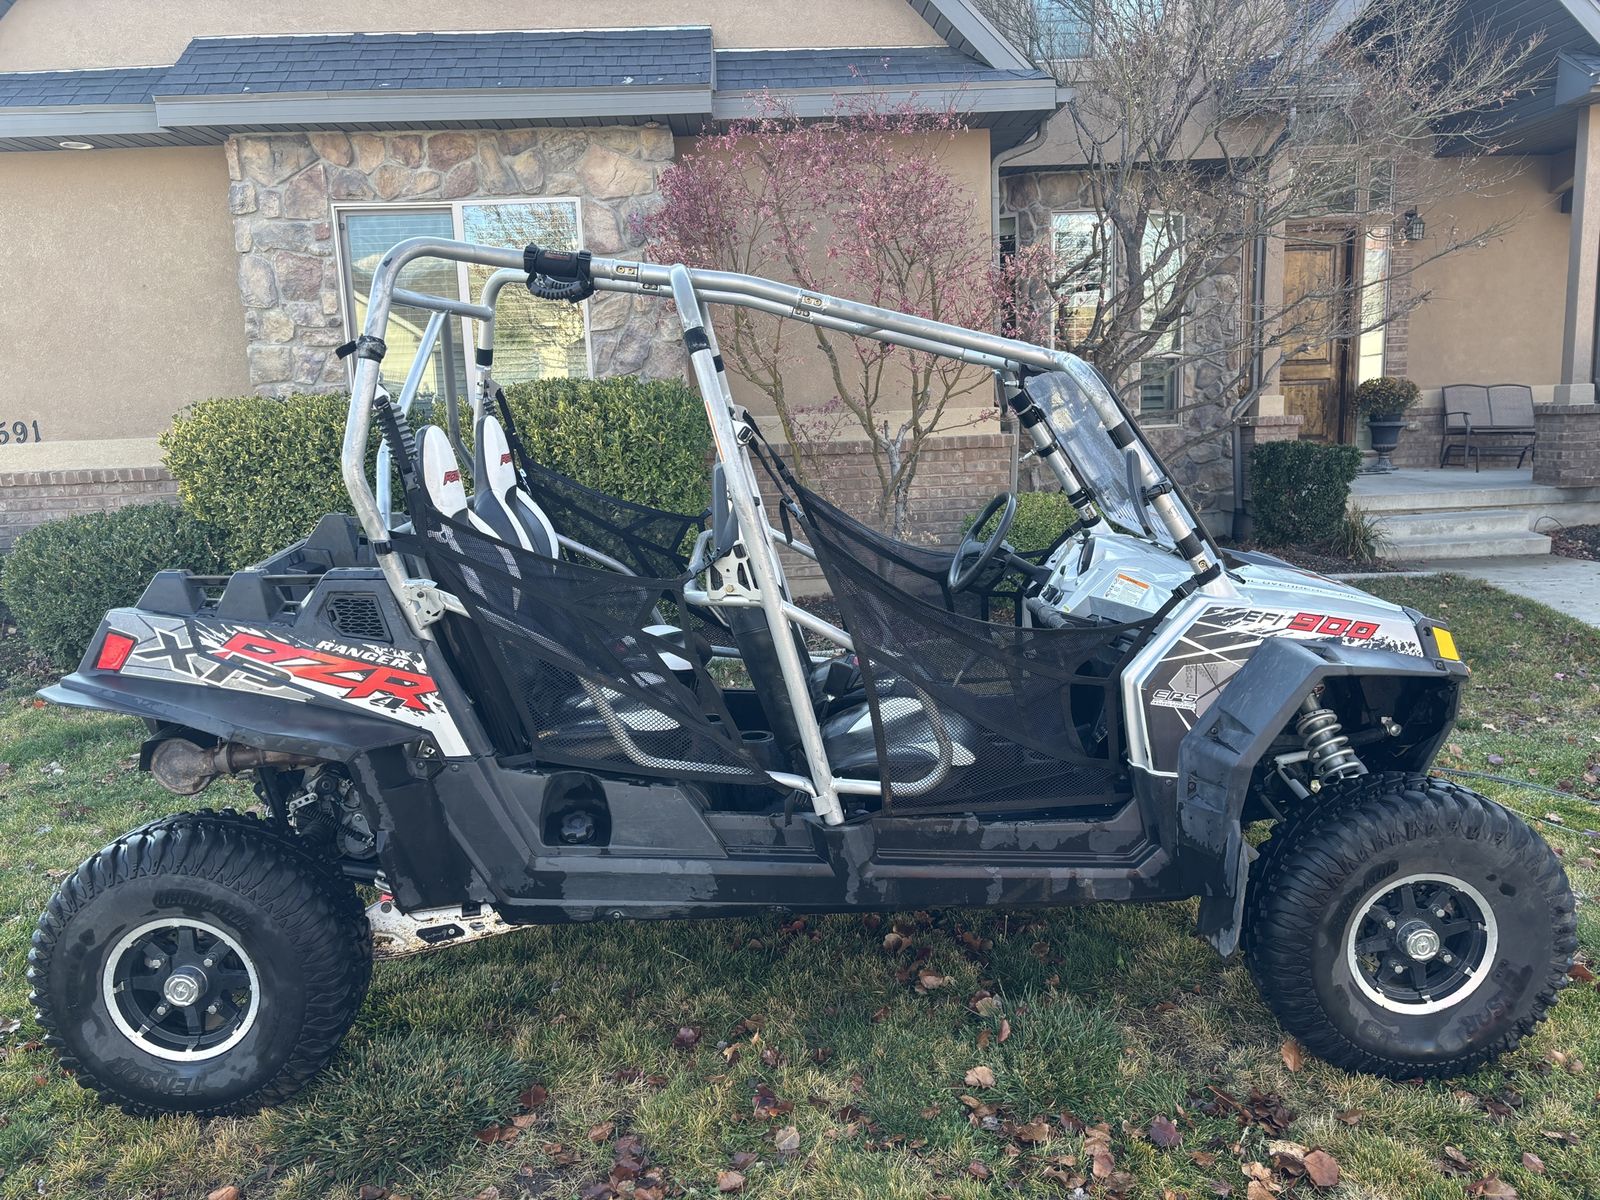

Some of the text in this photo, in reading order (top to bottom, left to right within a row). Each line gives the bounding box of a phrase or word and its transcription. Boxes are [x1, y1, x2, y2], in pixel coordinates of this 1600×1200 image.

[0, 420, 42, 446] 591
[1243, 610, 1381, 641] EFI 900
[131, 626, 294, 687] XP
[316, 639, 411, 671] RANGER
[212, 631, 439, 712] RZR
[1152, 689, 1200, 703] EPS
